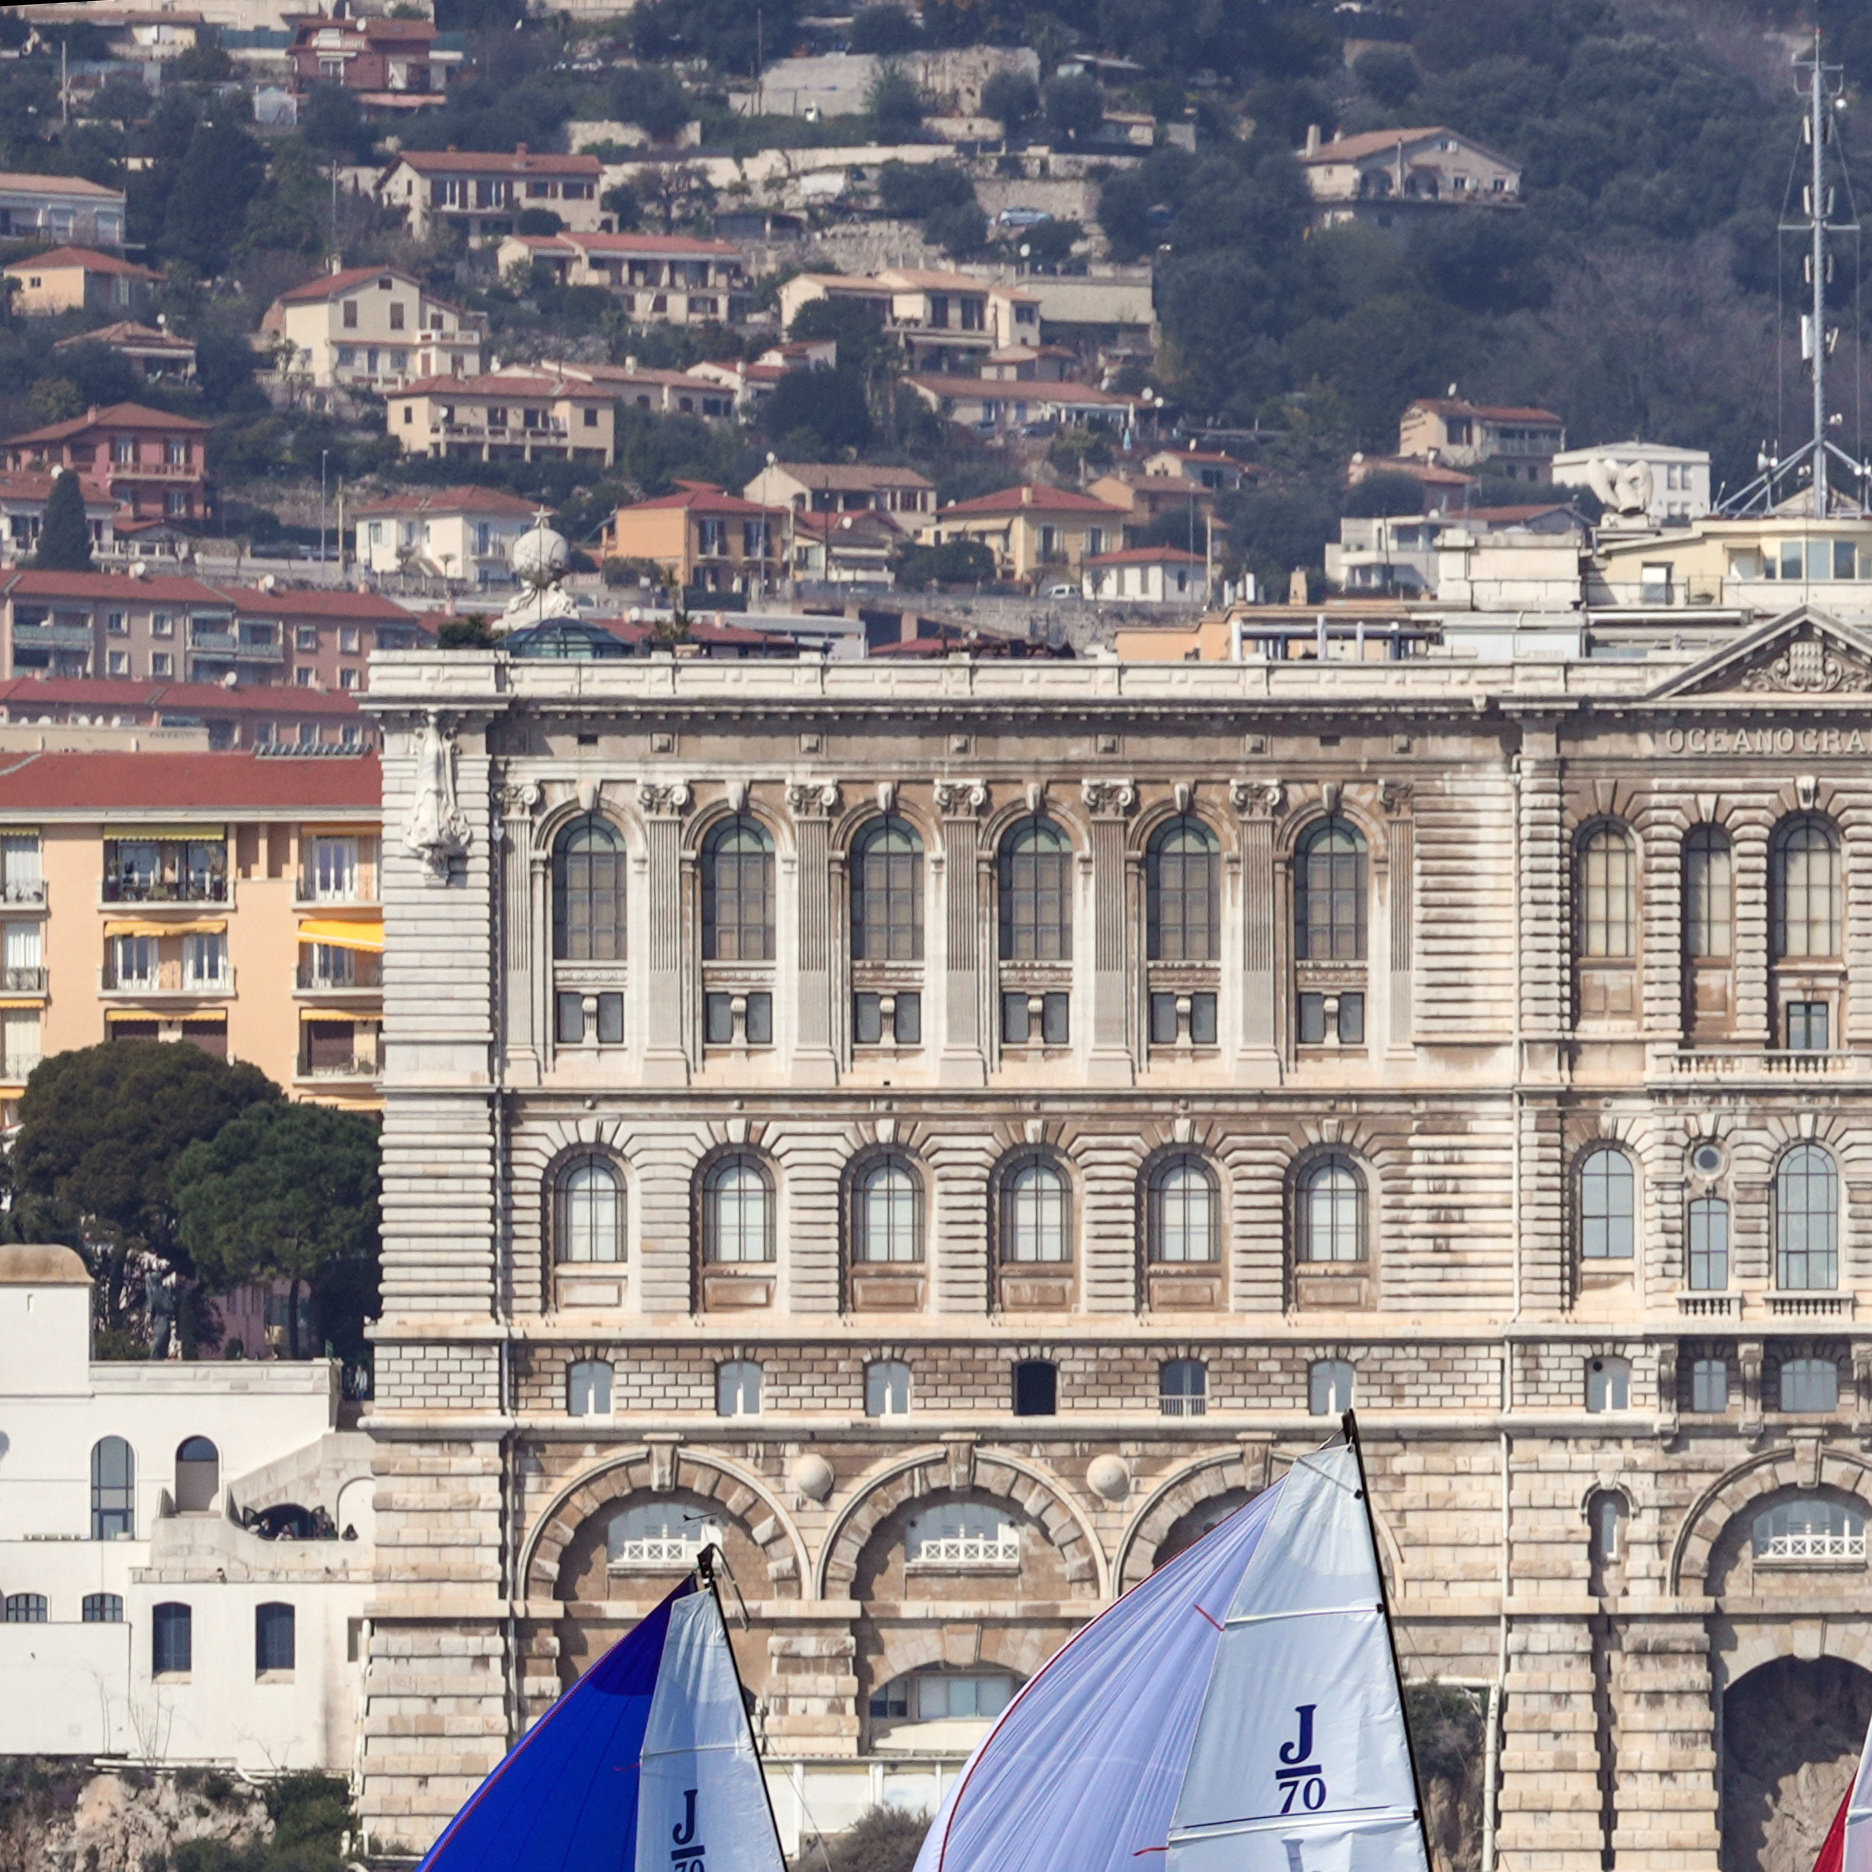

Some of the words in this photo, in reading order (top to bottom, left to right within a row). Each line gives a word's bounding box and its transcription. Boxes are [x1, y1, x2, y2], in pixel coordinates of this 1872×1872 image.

[1278, 1704, 1317, 1764] J
[672, 1789, 698, 1843] J
[1278, 1777, 1327, 1814] 70
